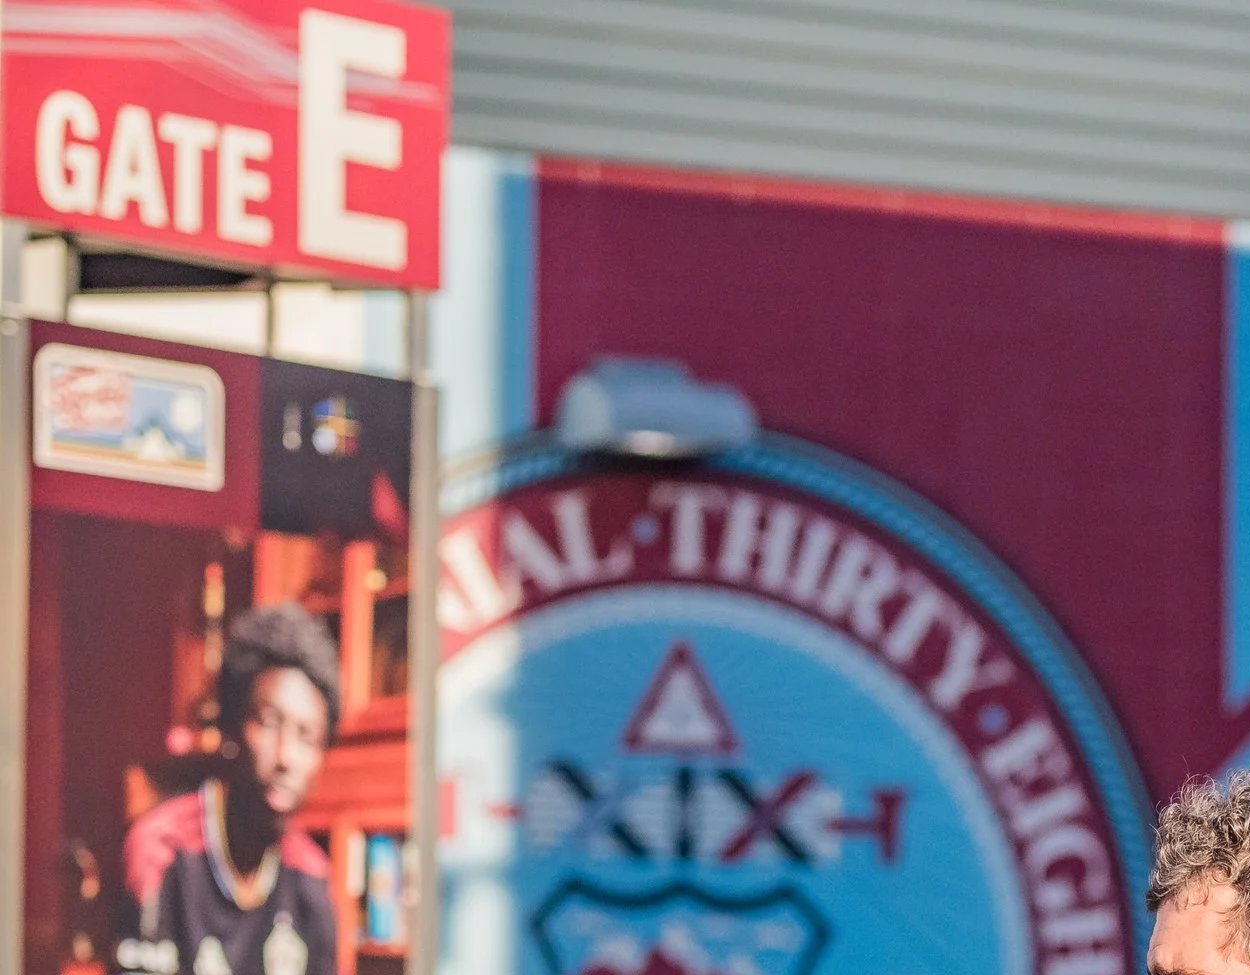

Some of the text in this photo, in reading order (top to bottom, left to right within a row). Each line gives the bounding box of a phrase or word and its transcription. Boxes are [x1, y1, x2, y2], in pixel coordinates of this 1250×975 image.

[35, 9, 407, 271] GATE E
[650, 482, 1014, 710] THIRTY
